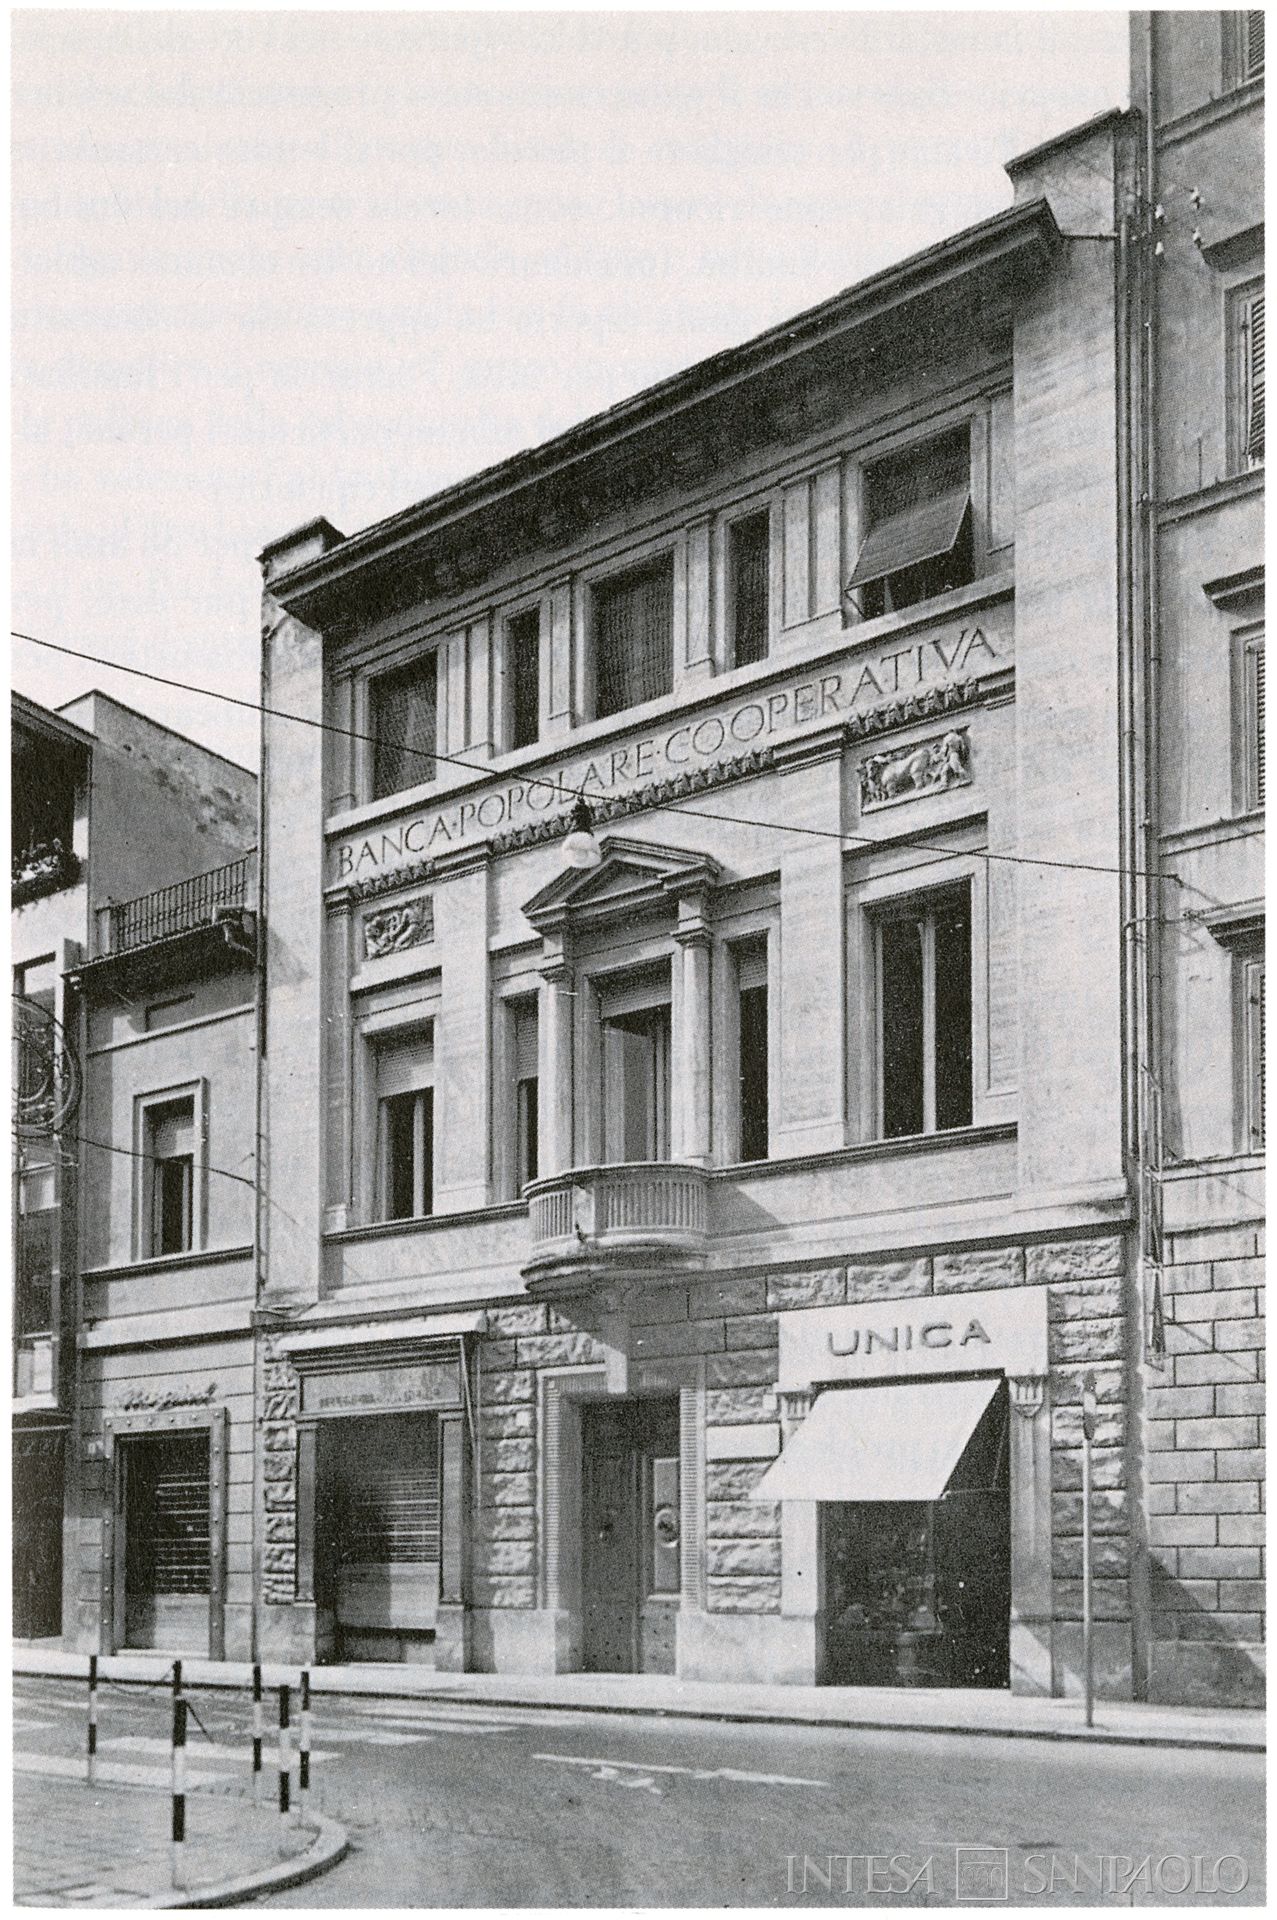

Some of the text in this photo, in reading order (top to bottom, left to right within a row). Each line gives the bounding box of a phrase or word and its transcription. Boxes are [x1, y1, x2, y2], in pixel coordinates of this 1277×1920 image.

[337, 625, 998, 878] BANCA POPOLARE COOPERATIVA
[827, 1318, 992, 1357] UNICA
